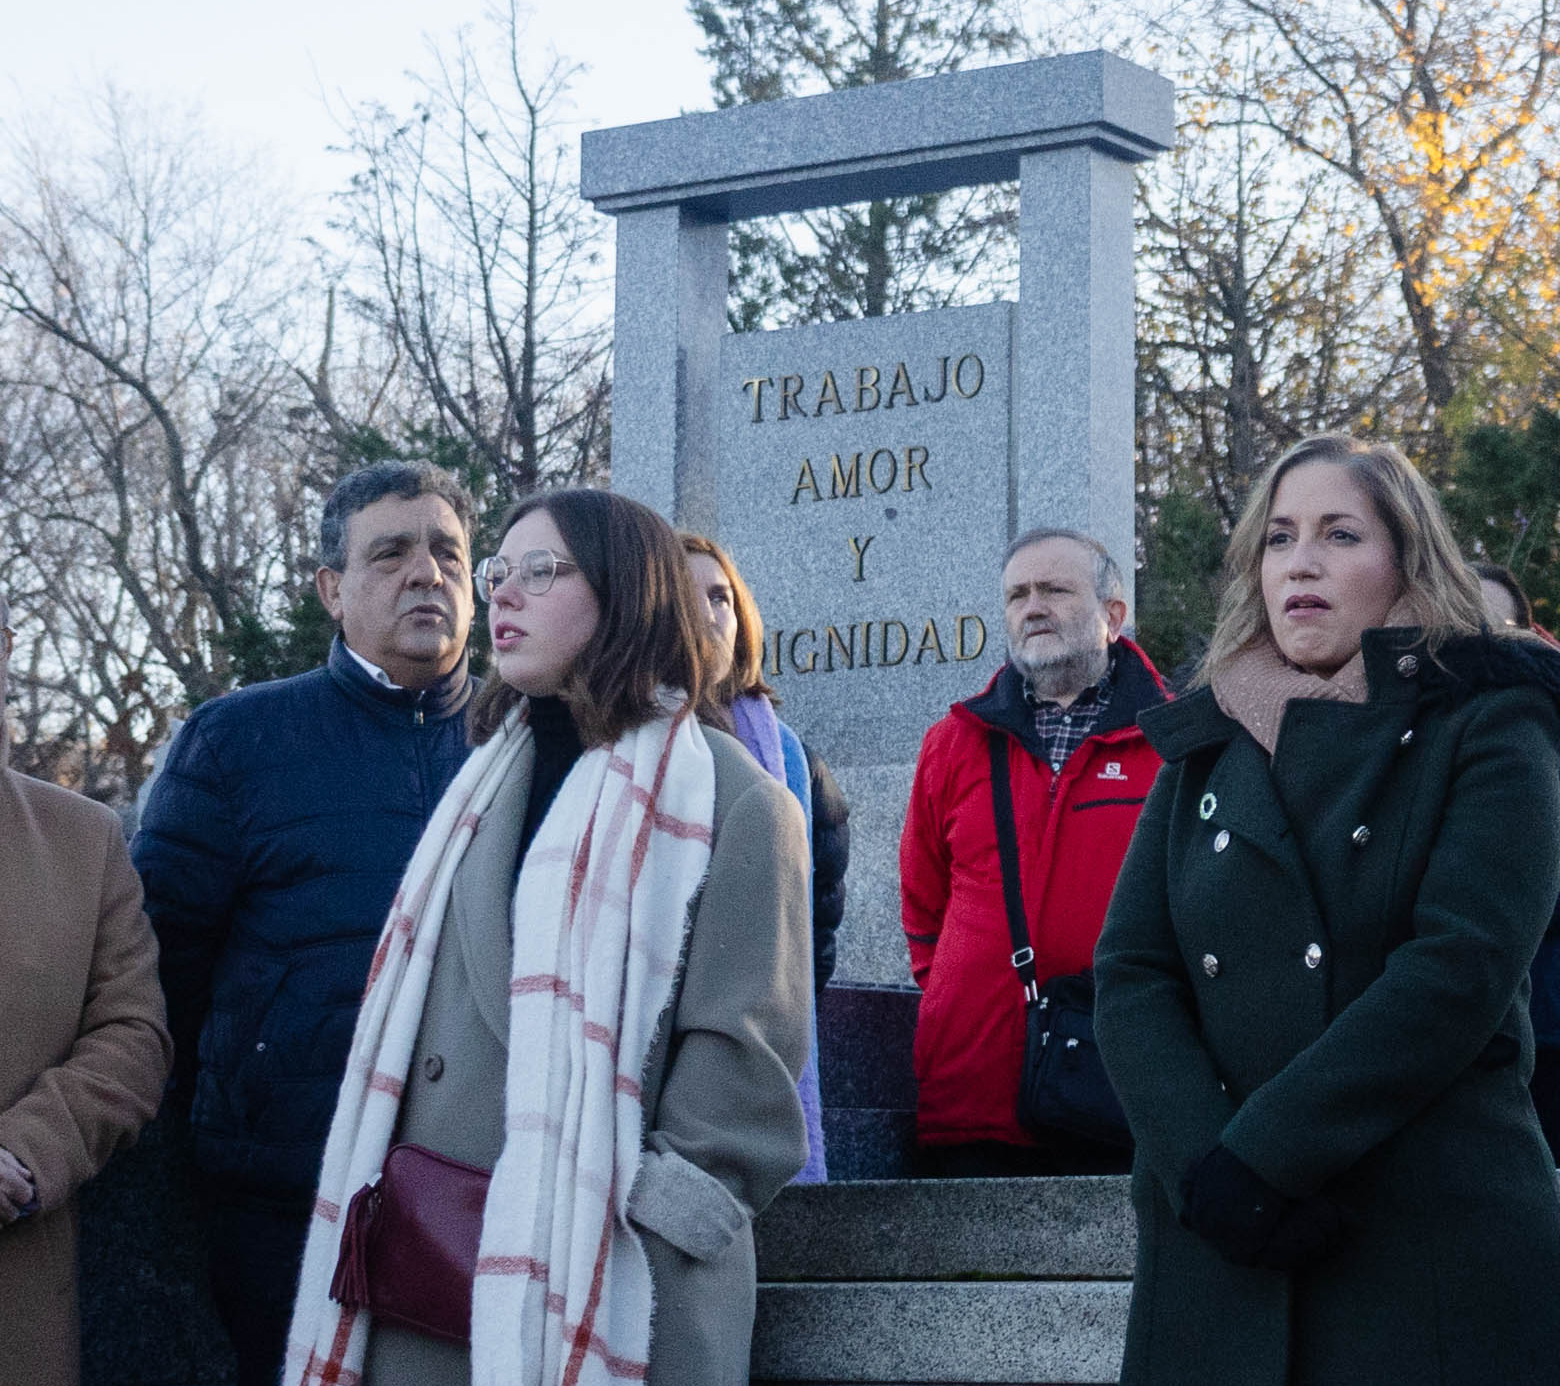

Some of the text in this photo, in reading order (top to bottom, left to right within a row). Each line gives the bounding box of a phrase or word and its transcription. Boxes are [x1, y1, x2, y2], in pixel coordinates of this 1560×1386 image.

[742, 353, 985, 424] TRABAJO
[790, 445, 933, 504] AMOR
[848, 535, 876, 582] Y
[761, 615, 987, 676] IGNIDAD
